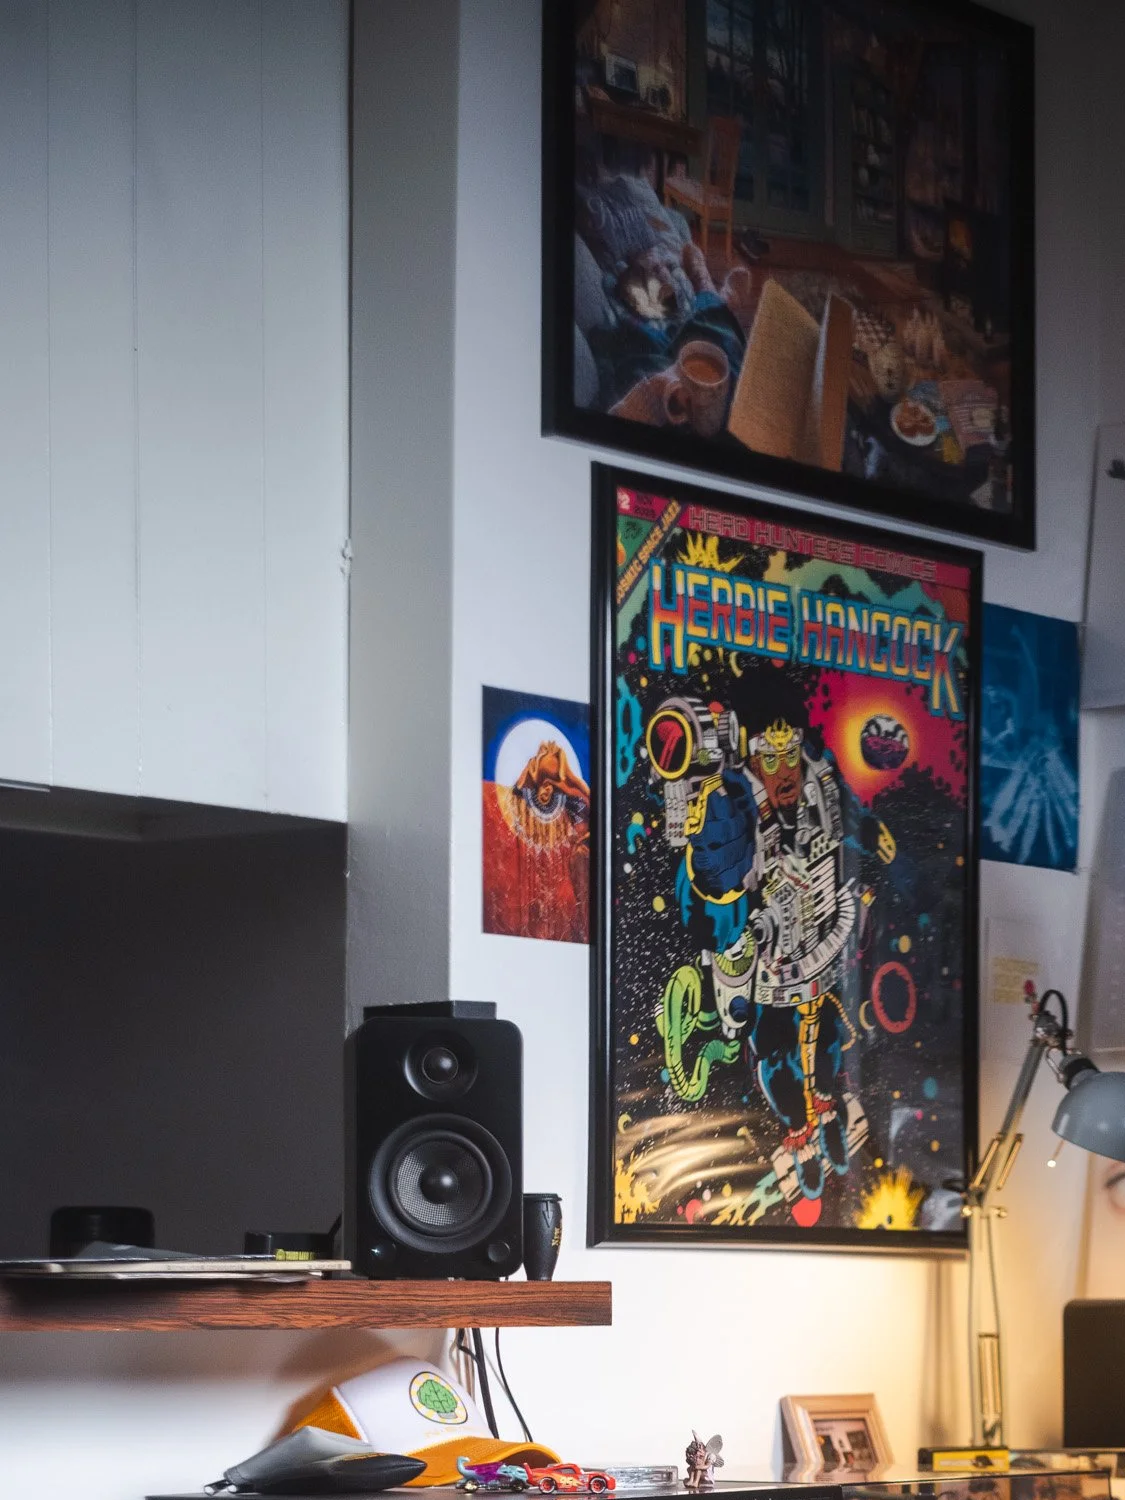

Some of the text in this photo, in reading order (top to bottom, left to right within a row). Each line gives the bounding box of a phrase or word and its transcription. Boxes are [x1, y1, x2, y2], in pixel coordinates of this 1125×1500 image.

[689, 503, 752, 541] HEAD
[754, 520, 857, 565] HUNTERS
[649, 558, 964, 720] HERBIE HANCOCK
